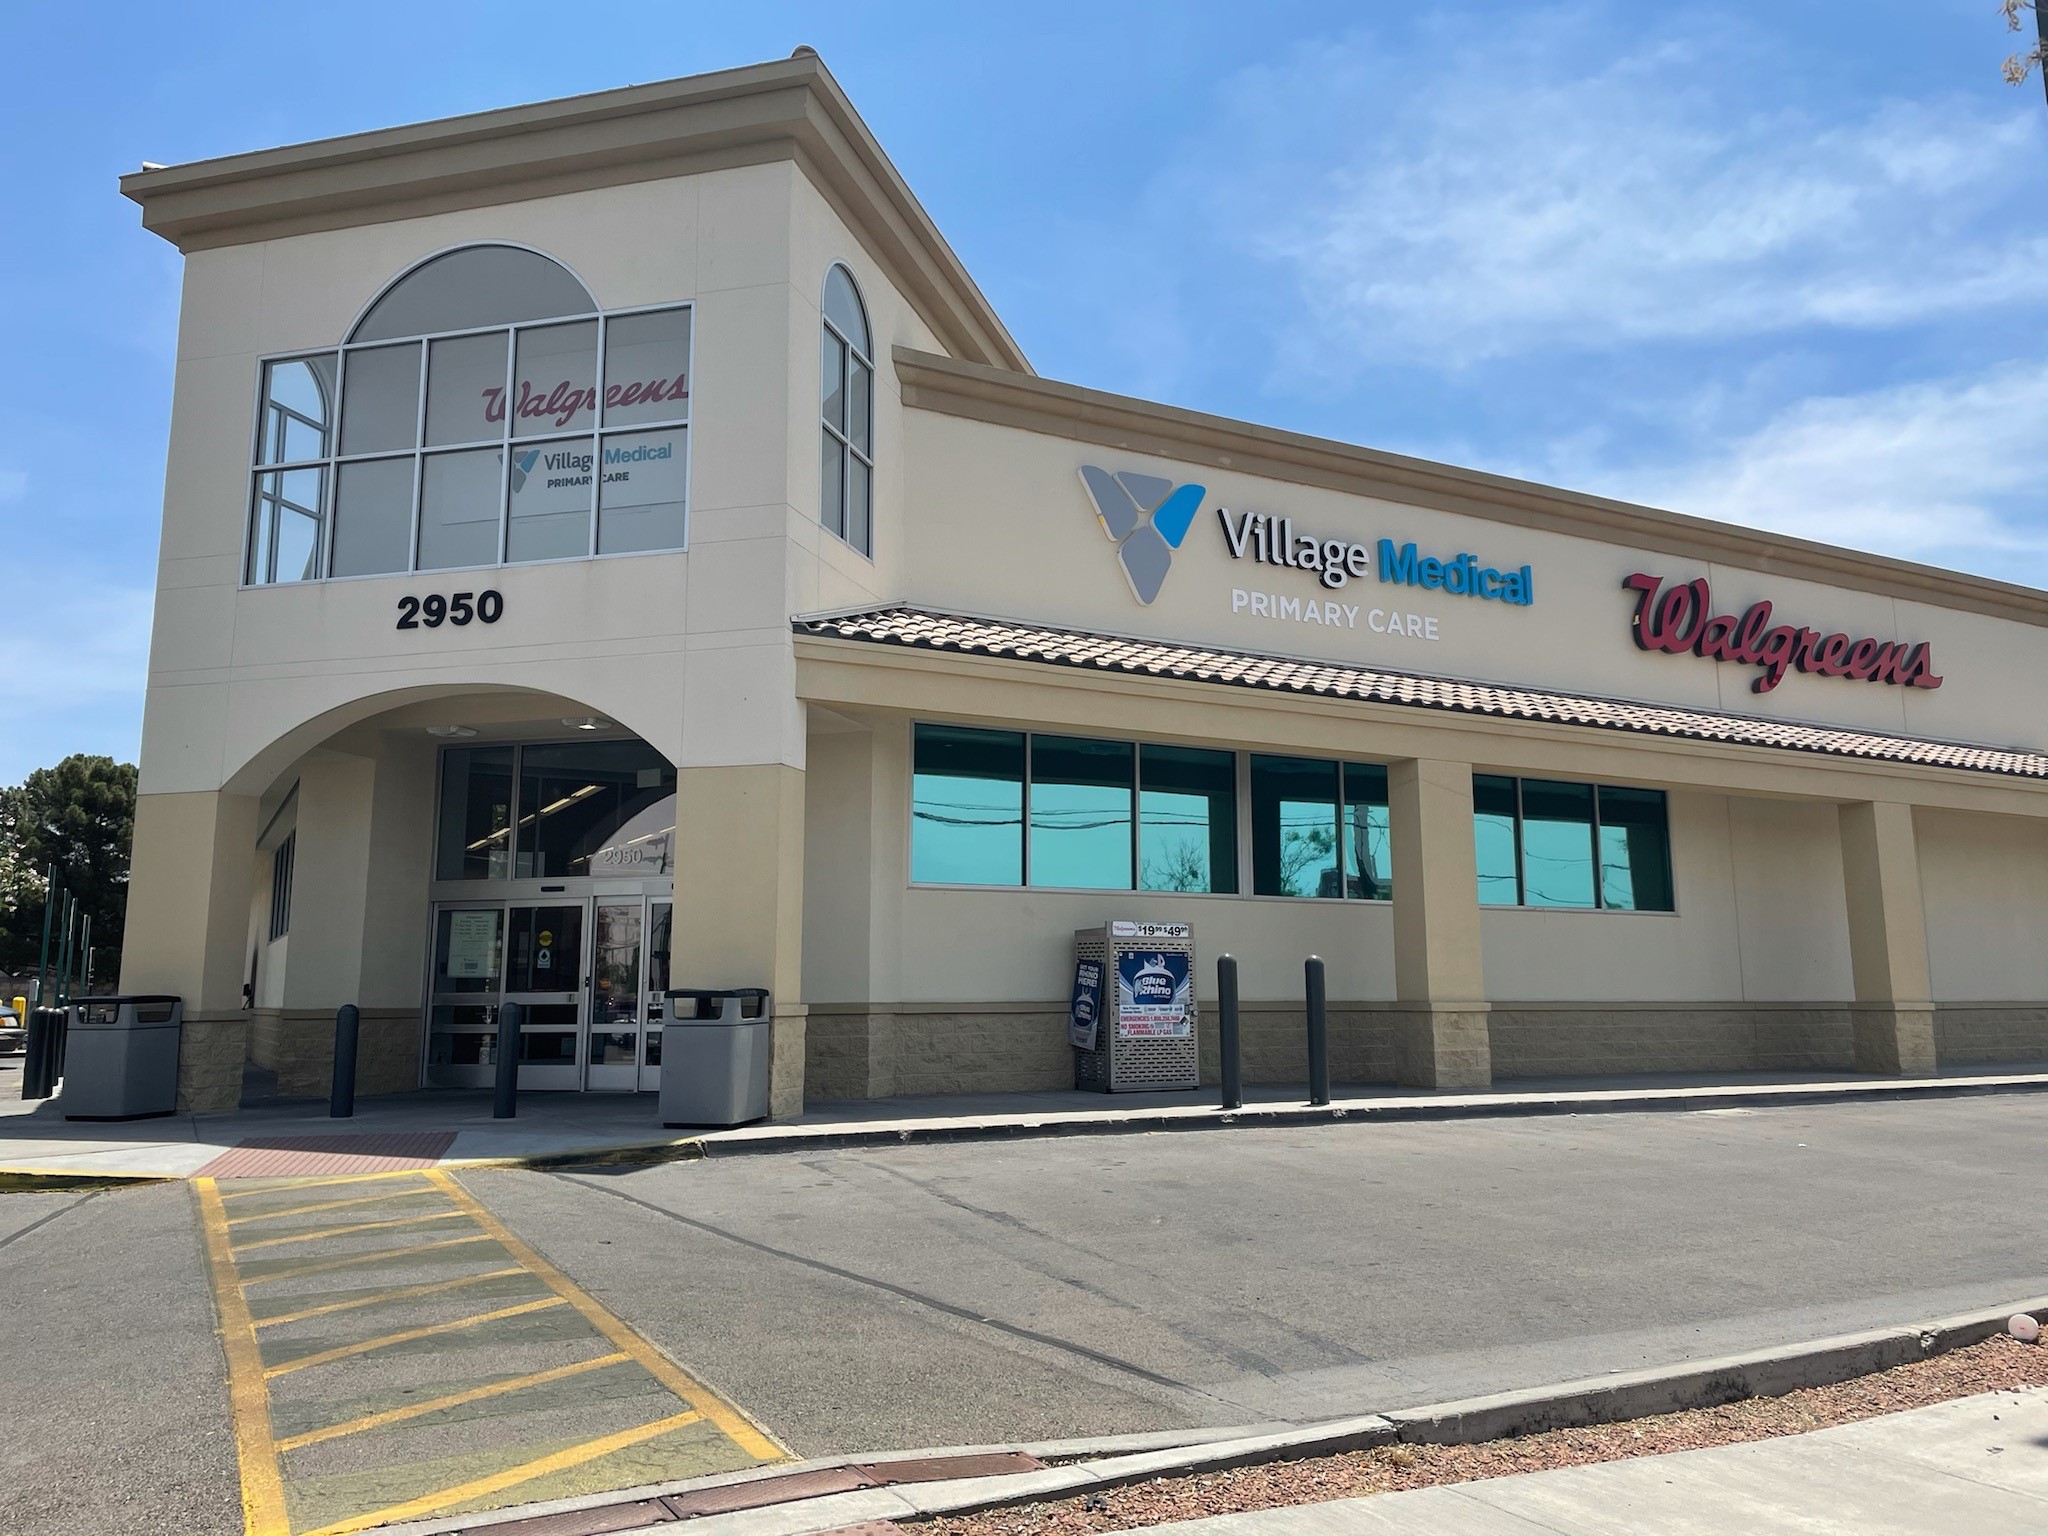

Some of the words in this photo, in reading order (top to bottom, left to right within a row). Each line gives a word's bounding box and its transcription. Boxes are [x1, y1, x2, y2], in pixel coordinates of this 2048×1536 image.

[482, 374, 688, 427] Walgreens
[544, 451, 593, 472] Villag
[605, 443, 672, 465] Medical
[1217, 508, 1370, 589] Village
[1378, 538, 1533, 606] Medical
[396, 590, 504, 629] 2950
[1231, 588, 1359, 630] PRIMARY
[1368, 608, 1440, 641] CARE
[1622, 573, 1943, 694] Walgreens
